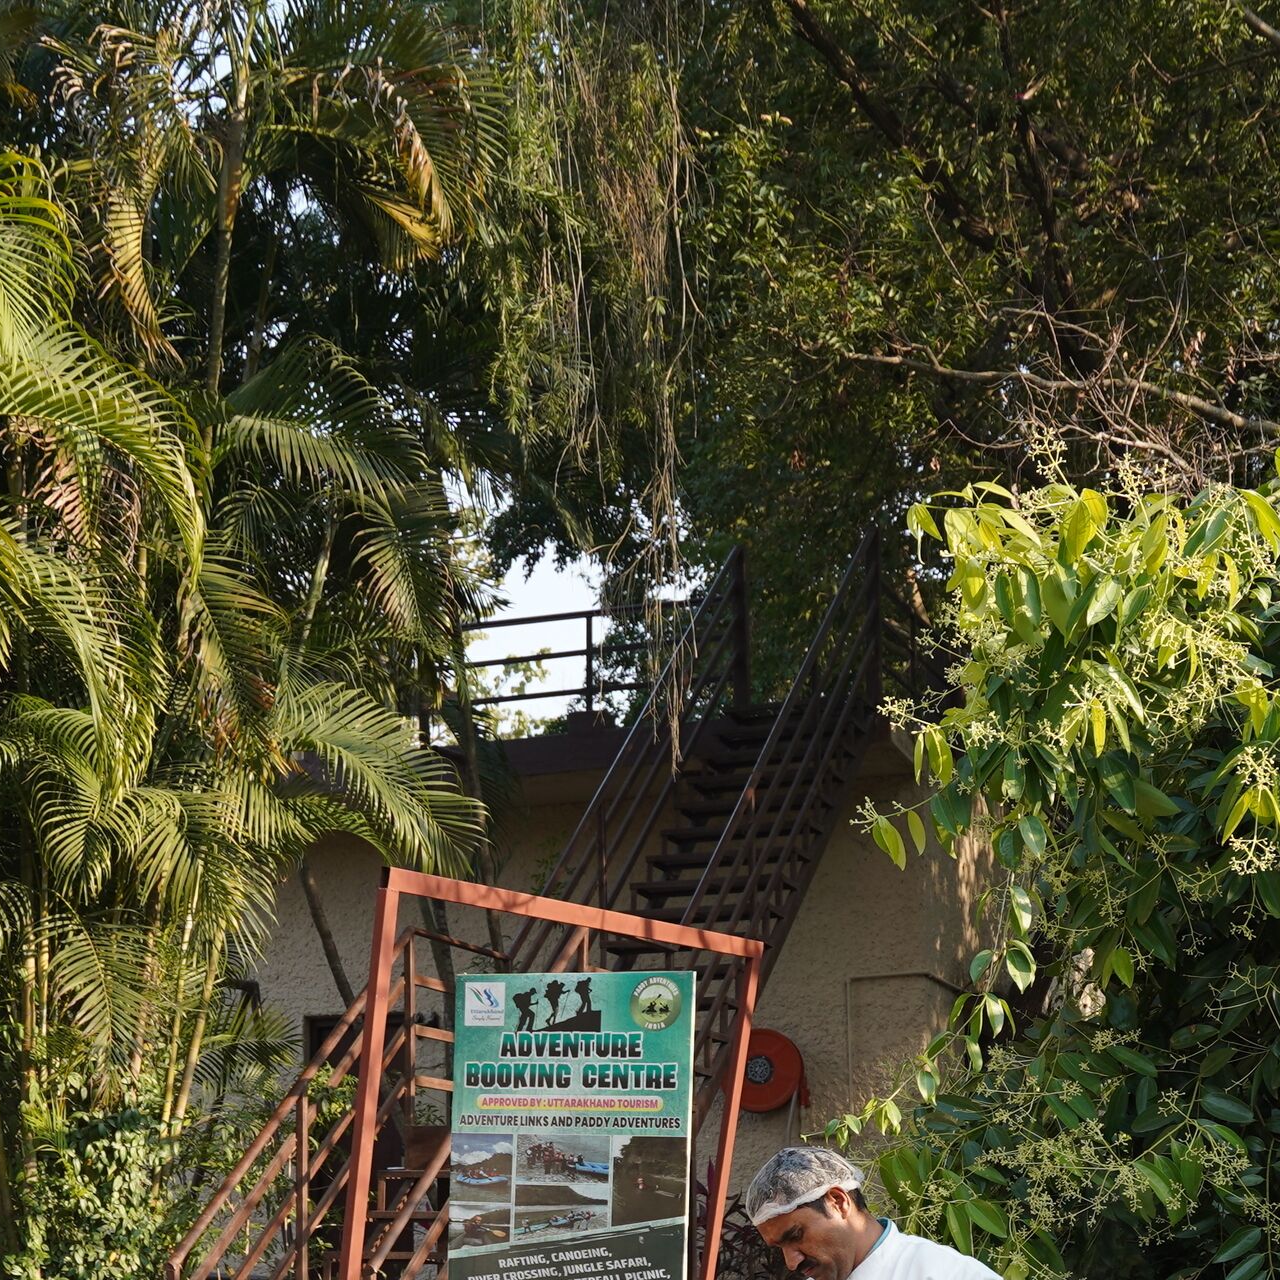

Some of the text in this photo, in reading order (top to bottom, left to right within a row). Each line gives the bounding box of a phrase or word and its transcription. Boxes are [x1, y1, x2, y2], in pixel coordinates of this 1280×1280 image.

[500, 1031, 643, 1059] ADVENTURE
[465, 1061, 678, 1090] BOOKING CENTRE
[481, 1097, 529, 1107] APPROVED
[530, 1098, 541, 1107] BY
[547, 1098, 616, 1109] UTTARAKHAND
[618, 1099, 658, 1109] TOURISM
[460, 1114, 680, 1129] ADVENTURE LINKS AND PADDY ADVENTURES
[498, 1247, 613, 1268] RAFTING, CANOEING,
[563, 1262, 604, 1277] JUNGLE
[605, 1256, 652, 1270] SAFARI,
